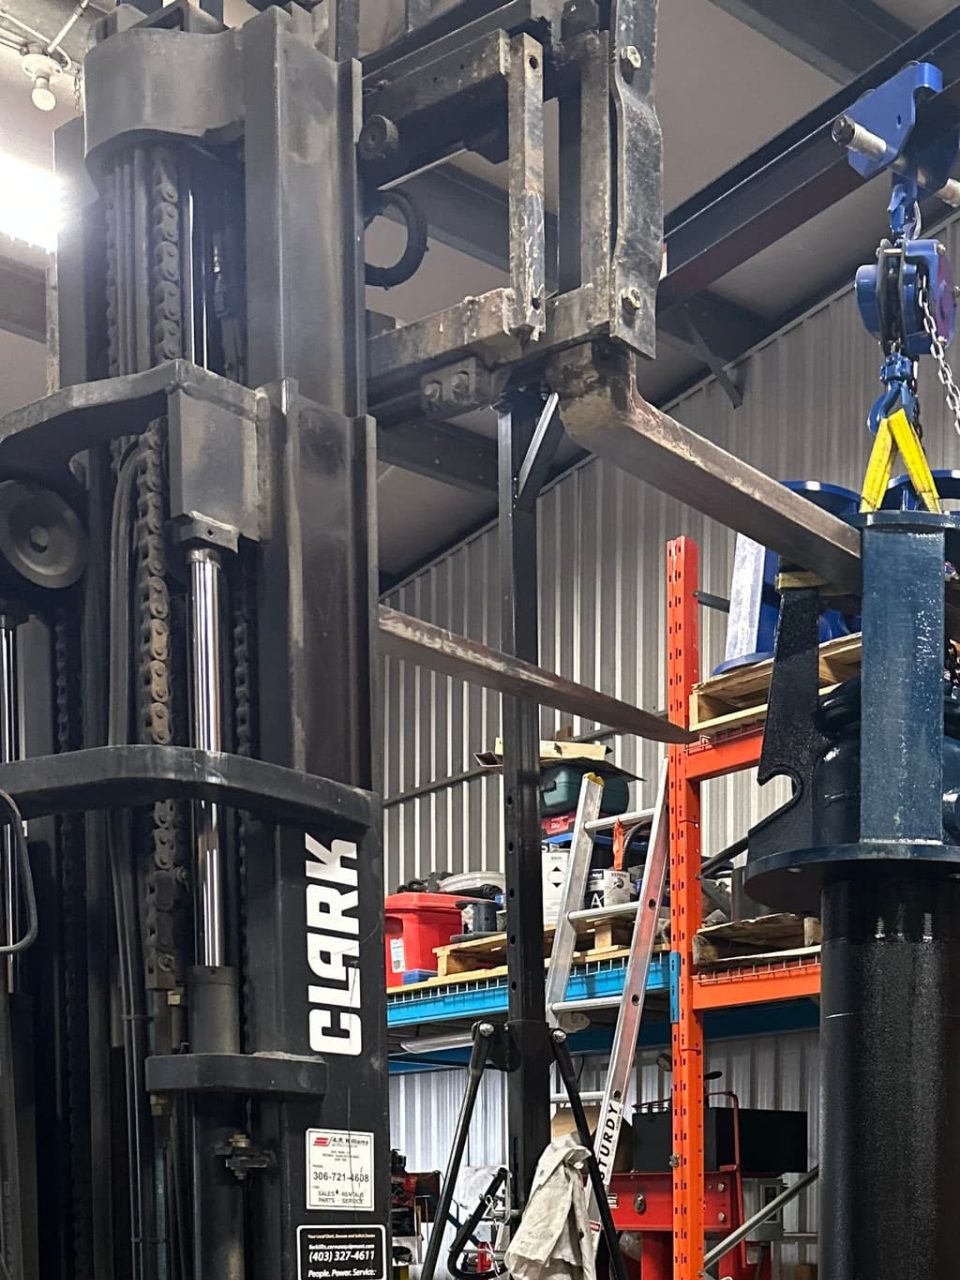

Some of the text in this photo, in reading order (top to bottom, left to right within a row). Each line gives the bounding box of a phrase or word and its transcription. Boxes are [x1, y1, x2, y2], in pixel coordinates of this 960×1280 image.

[304, 832, 363, 1056] CLARK
[309, 1250, 375, 1263] (403) 327-4611
